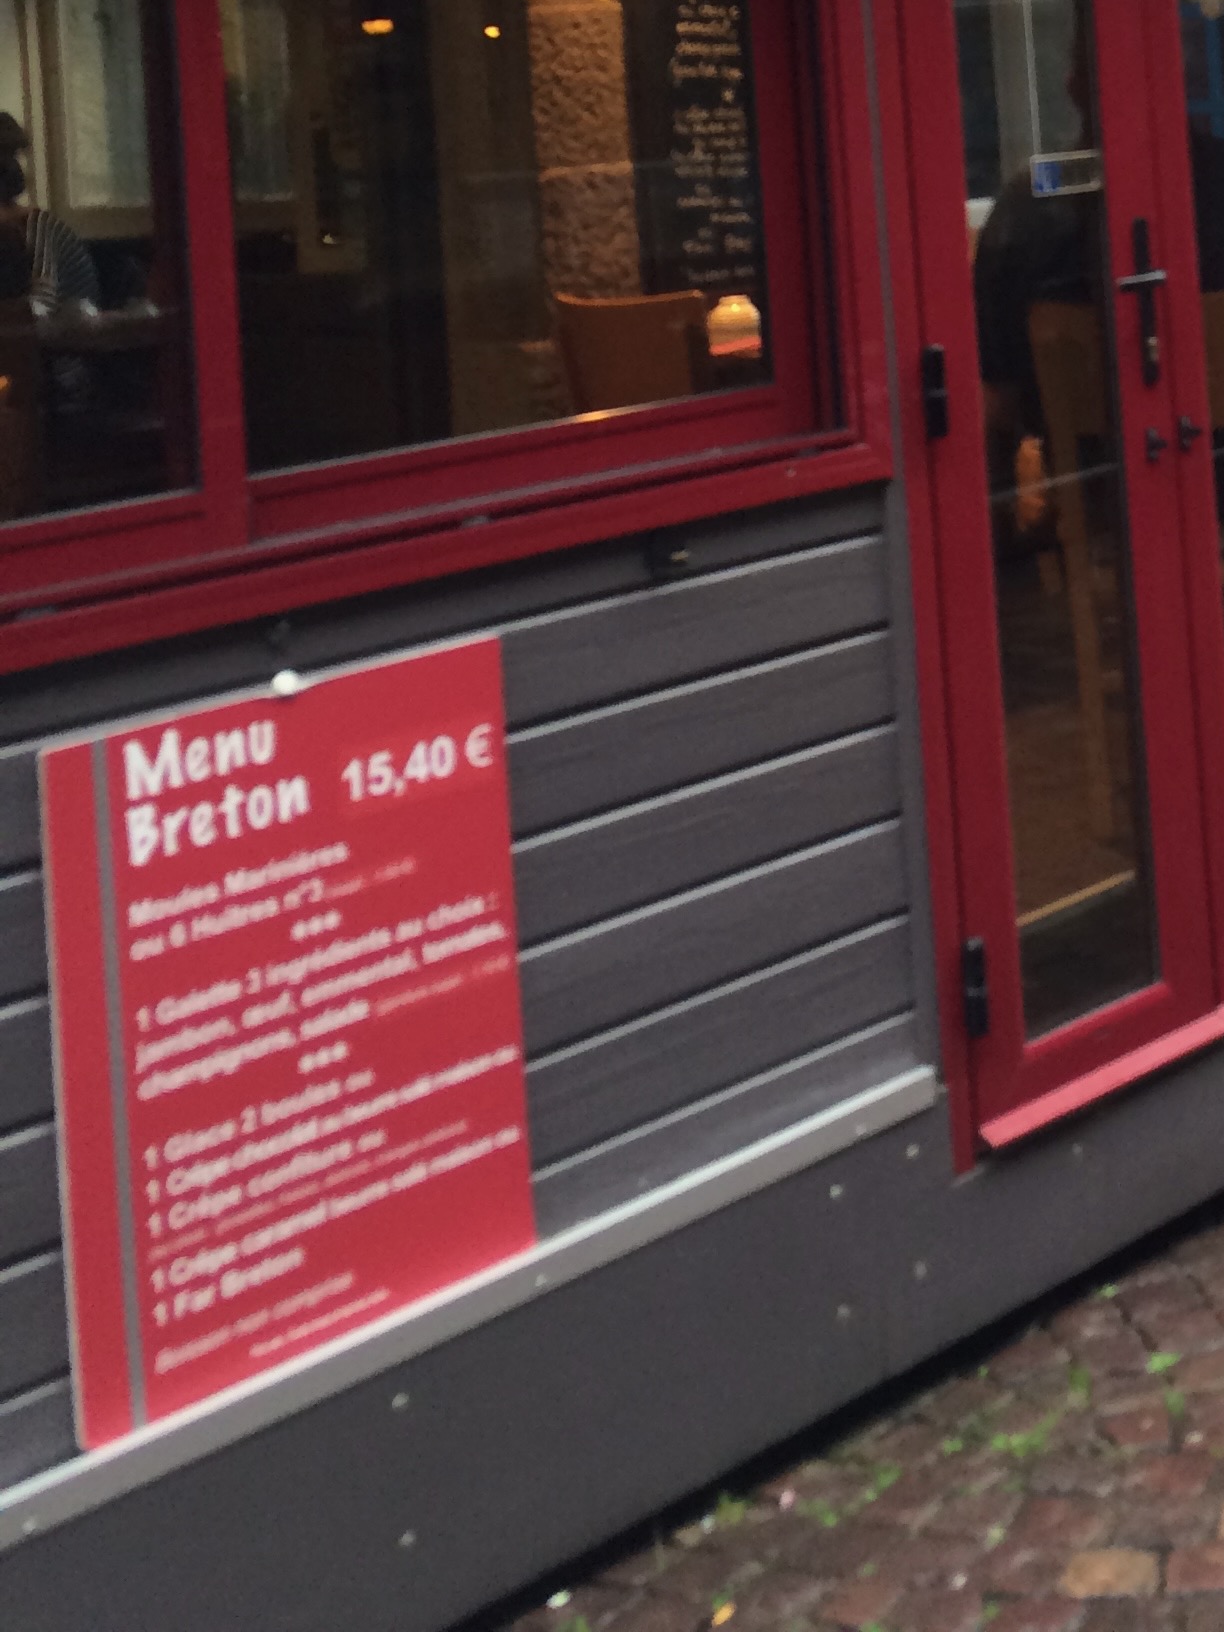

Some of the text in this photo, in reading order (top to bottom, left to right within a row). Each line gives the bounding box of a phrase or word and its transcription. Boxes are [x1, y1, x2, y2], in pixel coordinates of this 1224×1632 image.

[123, 720, 275, 799] Menu
[341, 722, 493, 800] 15,40 €
[125, 776, 309, 865] Breton
